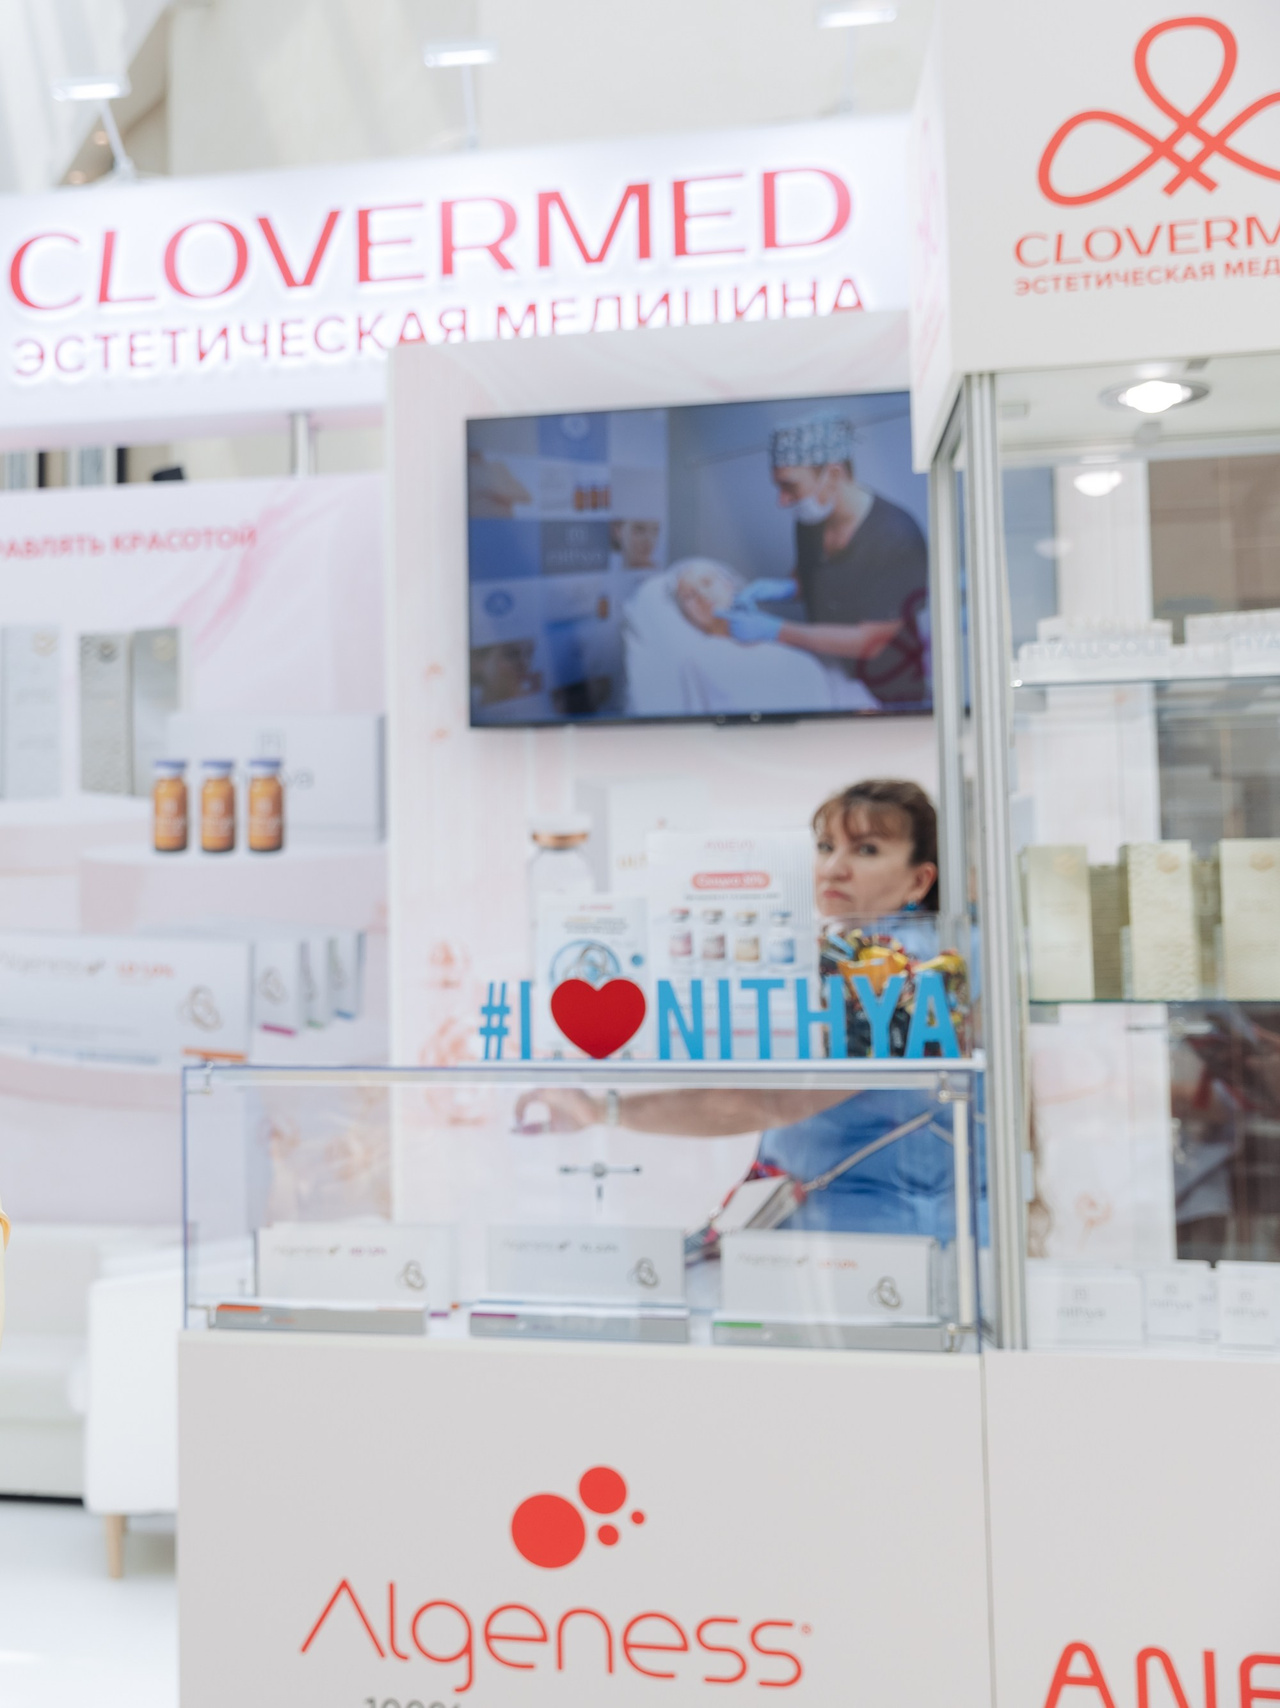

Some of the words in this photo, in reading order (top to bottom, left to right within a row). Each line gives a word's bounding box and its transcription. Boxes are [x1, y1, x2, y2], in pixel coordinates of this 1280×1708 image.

[10, 168, 851, 309] CLOVERMED
[1014, 214, 1280, 268] CLOVERM
[1014, 261, 1215, 296] ЭСТЕТИЧЕСКАЯ
[14, 309, 467, 376] ЭСТЕТИЧЕСКАЯ
[110, 523, 257, 554] КРАСОТОЙ
[657, 973, 961, 1060] NITHYA
[301, 1578, 802, 1694] Algeness
